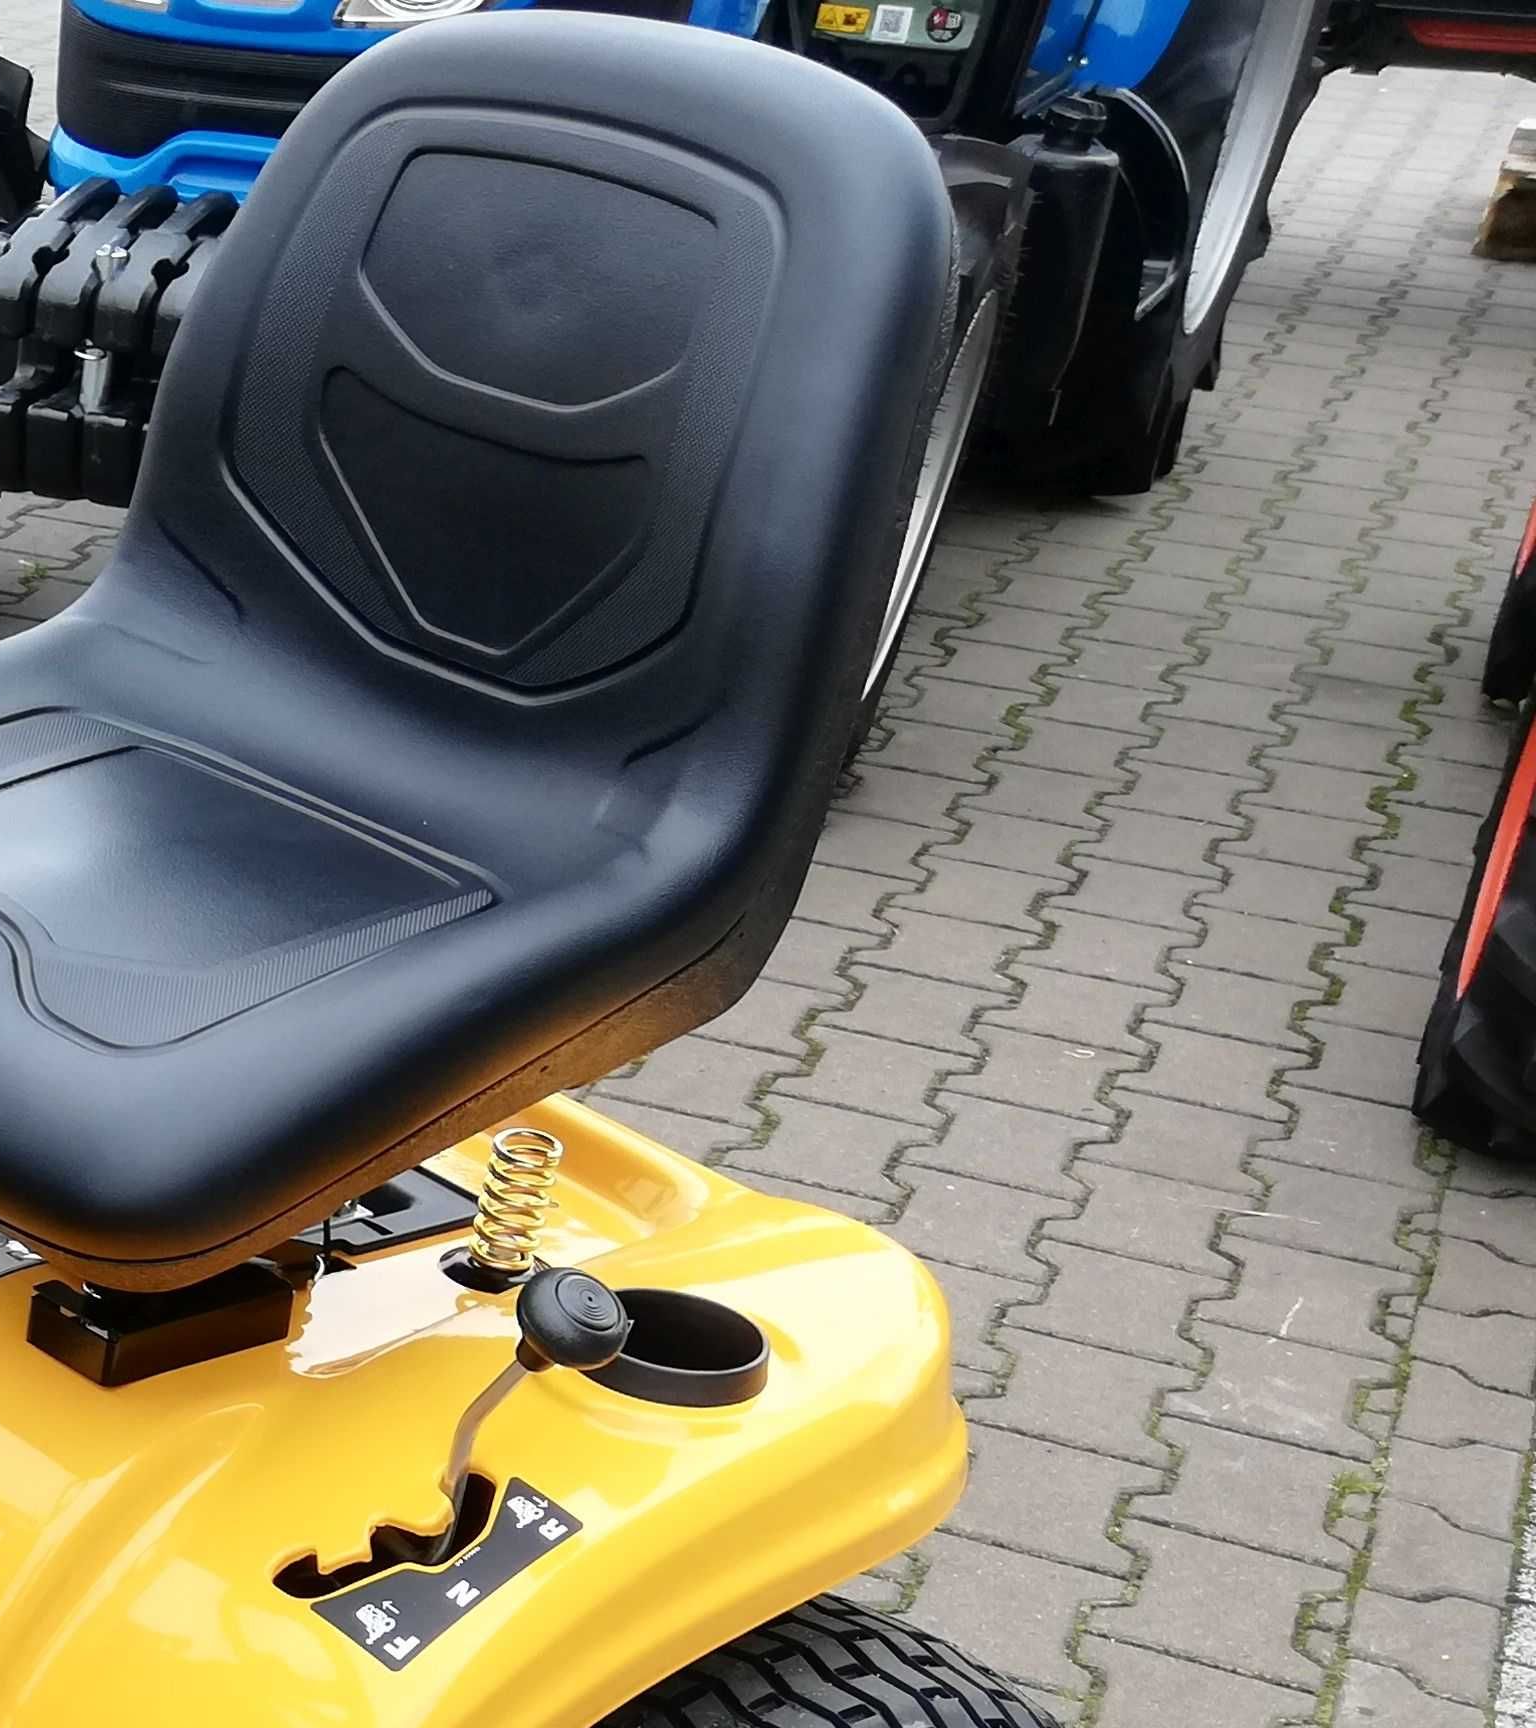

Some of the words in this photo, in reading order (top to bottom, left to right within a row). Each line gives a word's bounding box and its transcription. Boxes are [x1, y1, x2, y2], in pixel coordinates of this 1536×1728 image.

[539, 1518, 568, 1541] R
[446, 1580, 480, 1607] N
[383, 1635, 420, 1660] F
